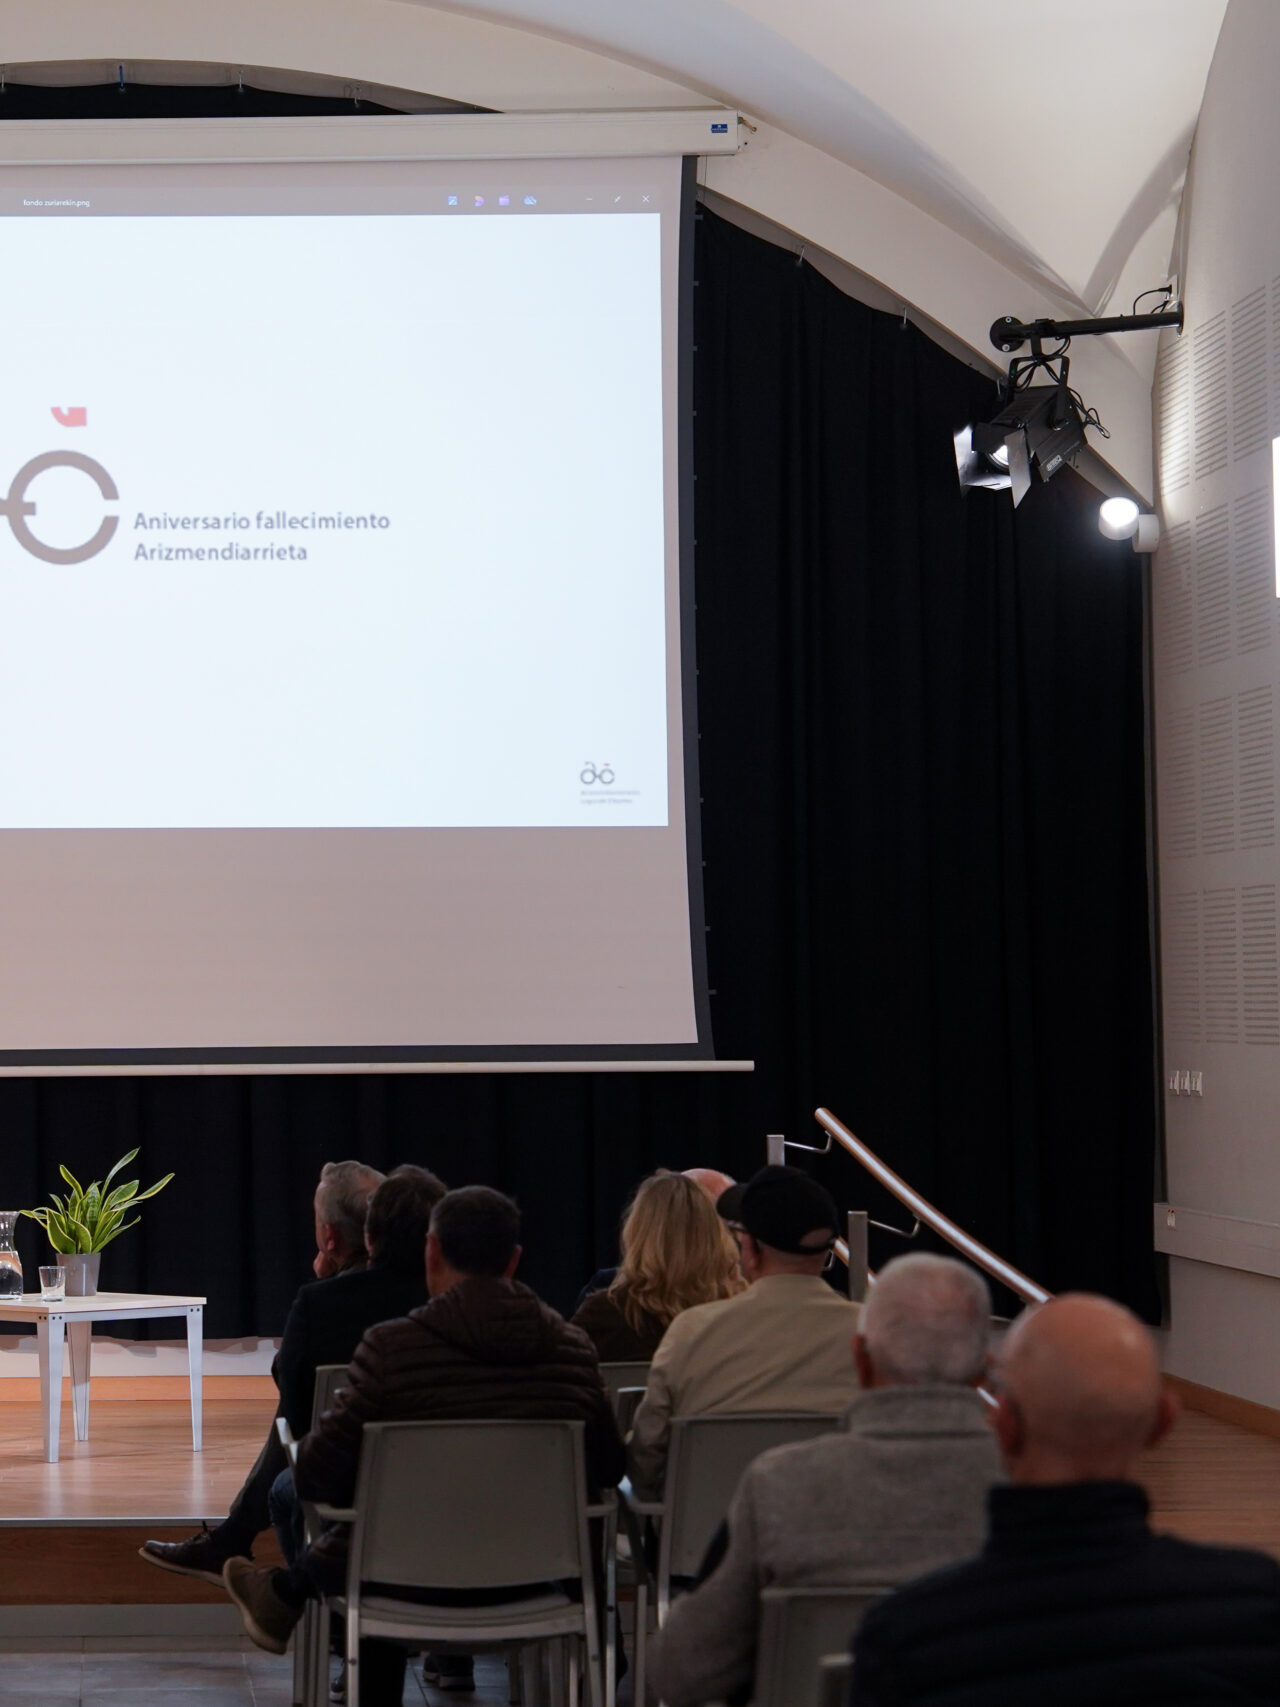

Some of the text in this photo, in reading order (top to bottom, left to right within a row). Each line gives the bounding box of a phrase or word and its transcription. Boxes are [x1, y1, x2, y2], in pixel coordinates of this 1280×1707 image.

[134, 511, 391, 530] Aniversario fallecimiento
[134, 542, 308, 561] Arizmendiarrieta
